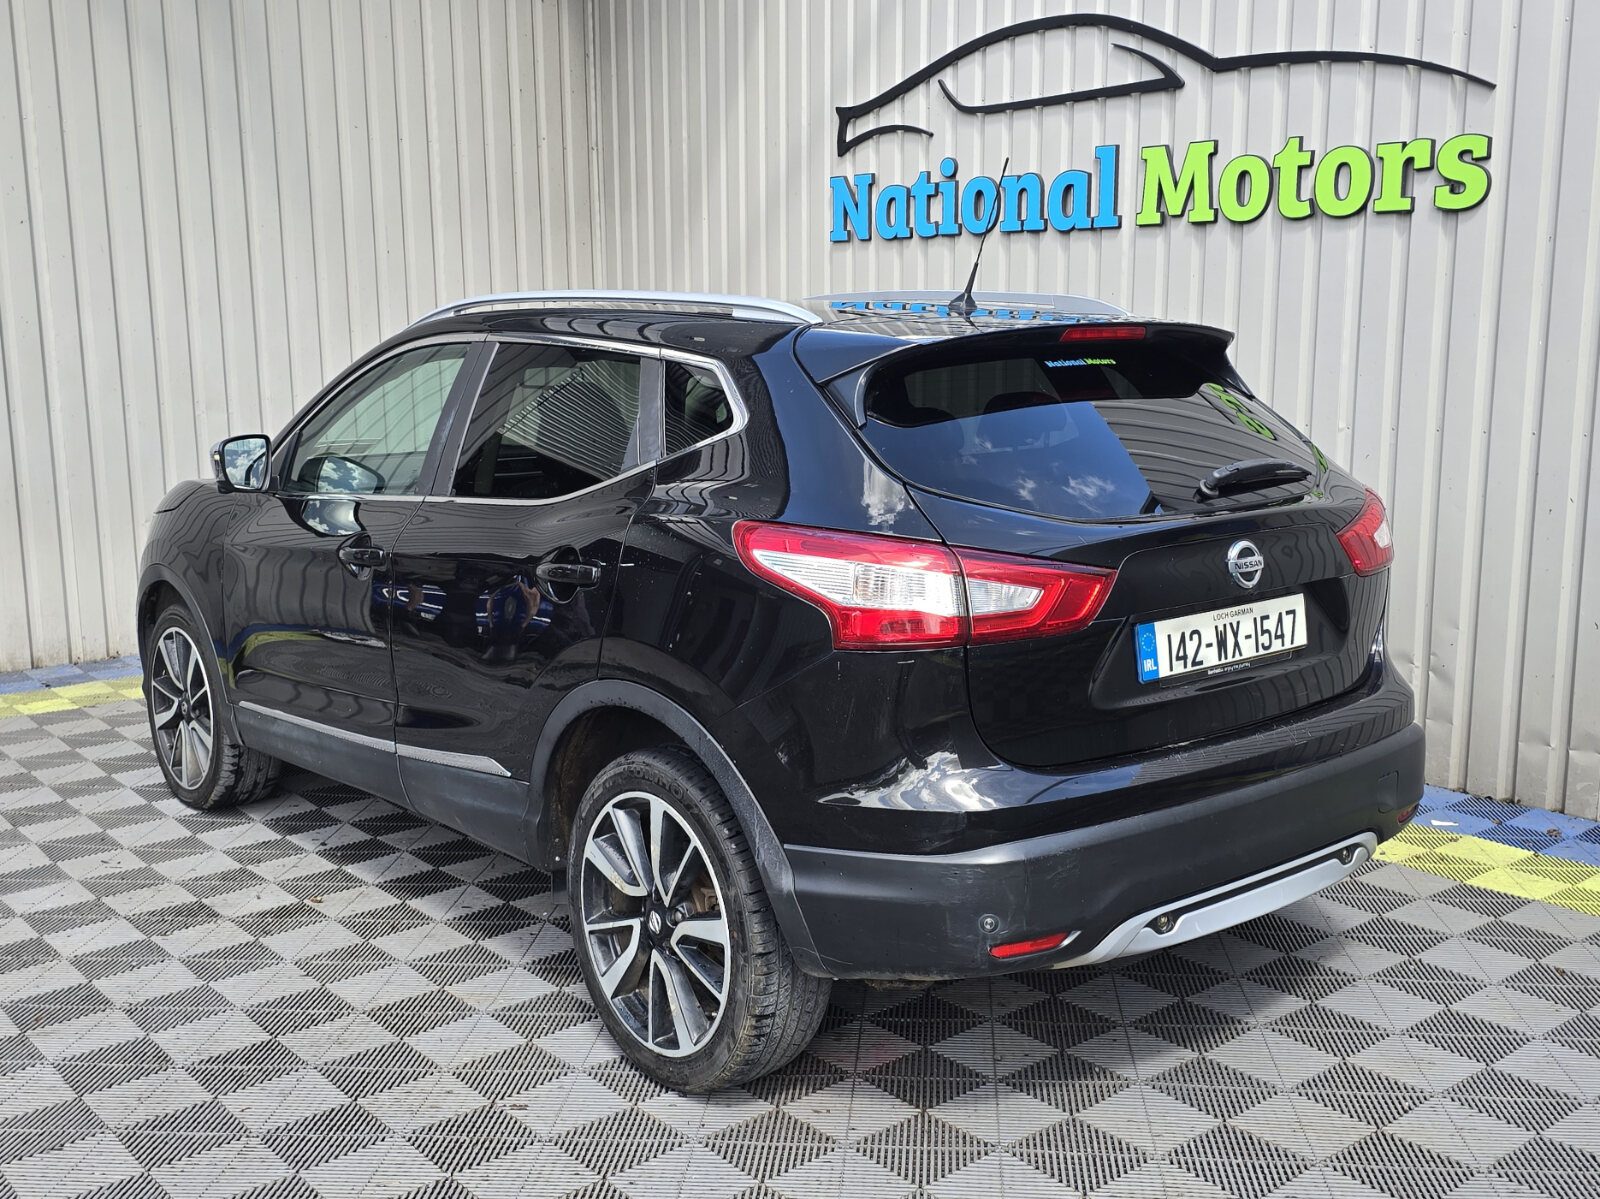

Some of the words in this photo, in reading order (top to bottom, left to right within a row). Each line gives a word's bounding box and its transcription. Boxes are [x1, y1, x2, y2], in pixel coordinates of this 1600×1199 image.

[829, 144, 1122, 242] National
[1136, 132, 1492, 226] Motors
[1044, 358, 1086, 367] National
[1234, 560, 1263, 570] NISSAN
[1213, 612, 1229, 621] LOCH
[1229, 607, 1254, 618] GARMAN
[1167, 609, 1296, 672] 142-WX-1547
[1143, 659, 1157, 672] IRL
